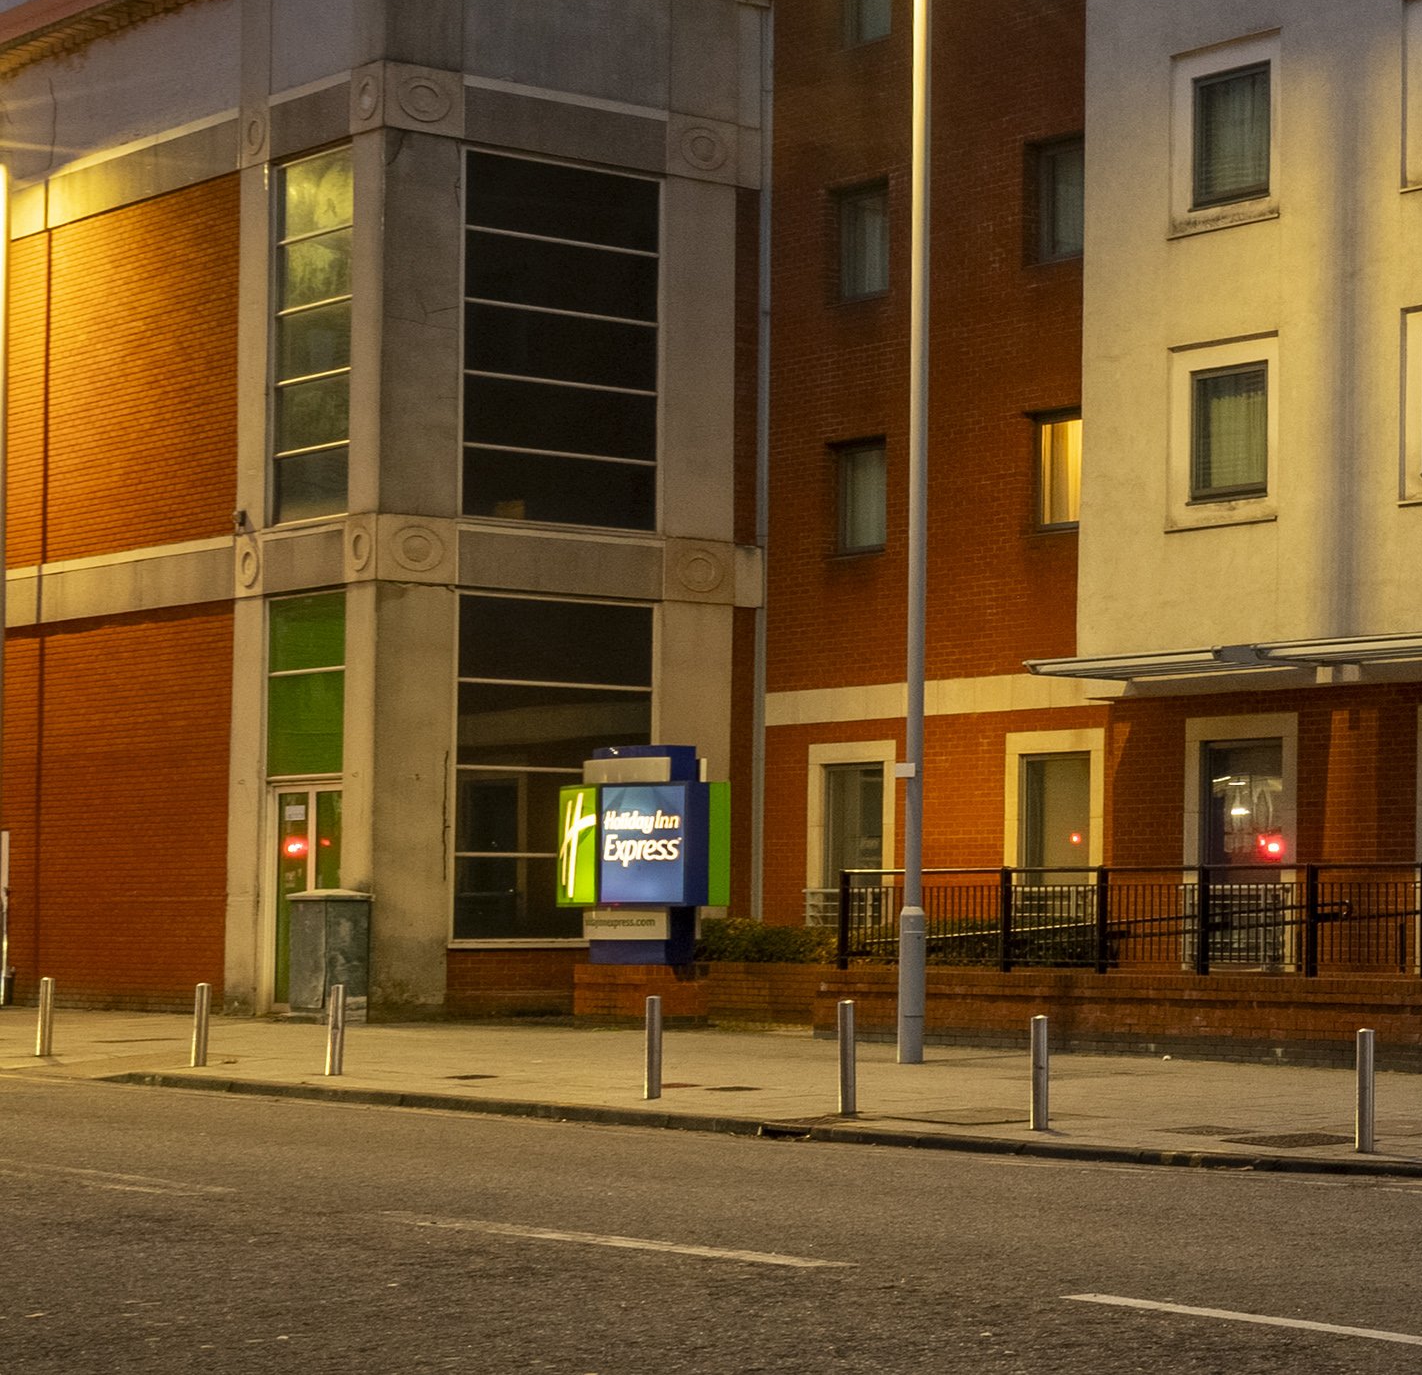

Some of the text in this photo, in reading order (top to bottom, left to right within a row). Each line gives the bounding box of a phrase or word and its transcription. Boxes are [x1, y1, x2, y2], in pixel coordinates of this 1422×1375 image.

[603, 810, 680, 834] Holiday Inn
[603, 834, 680, 867] Express
